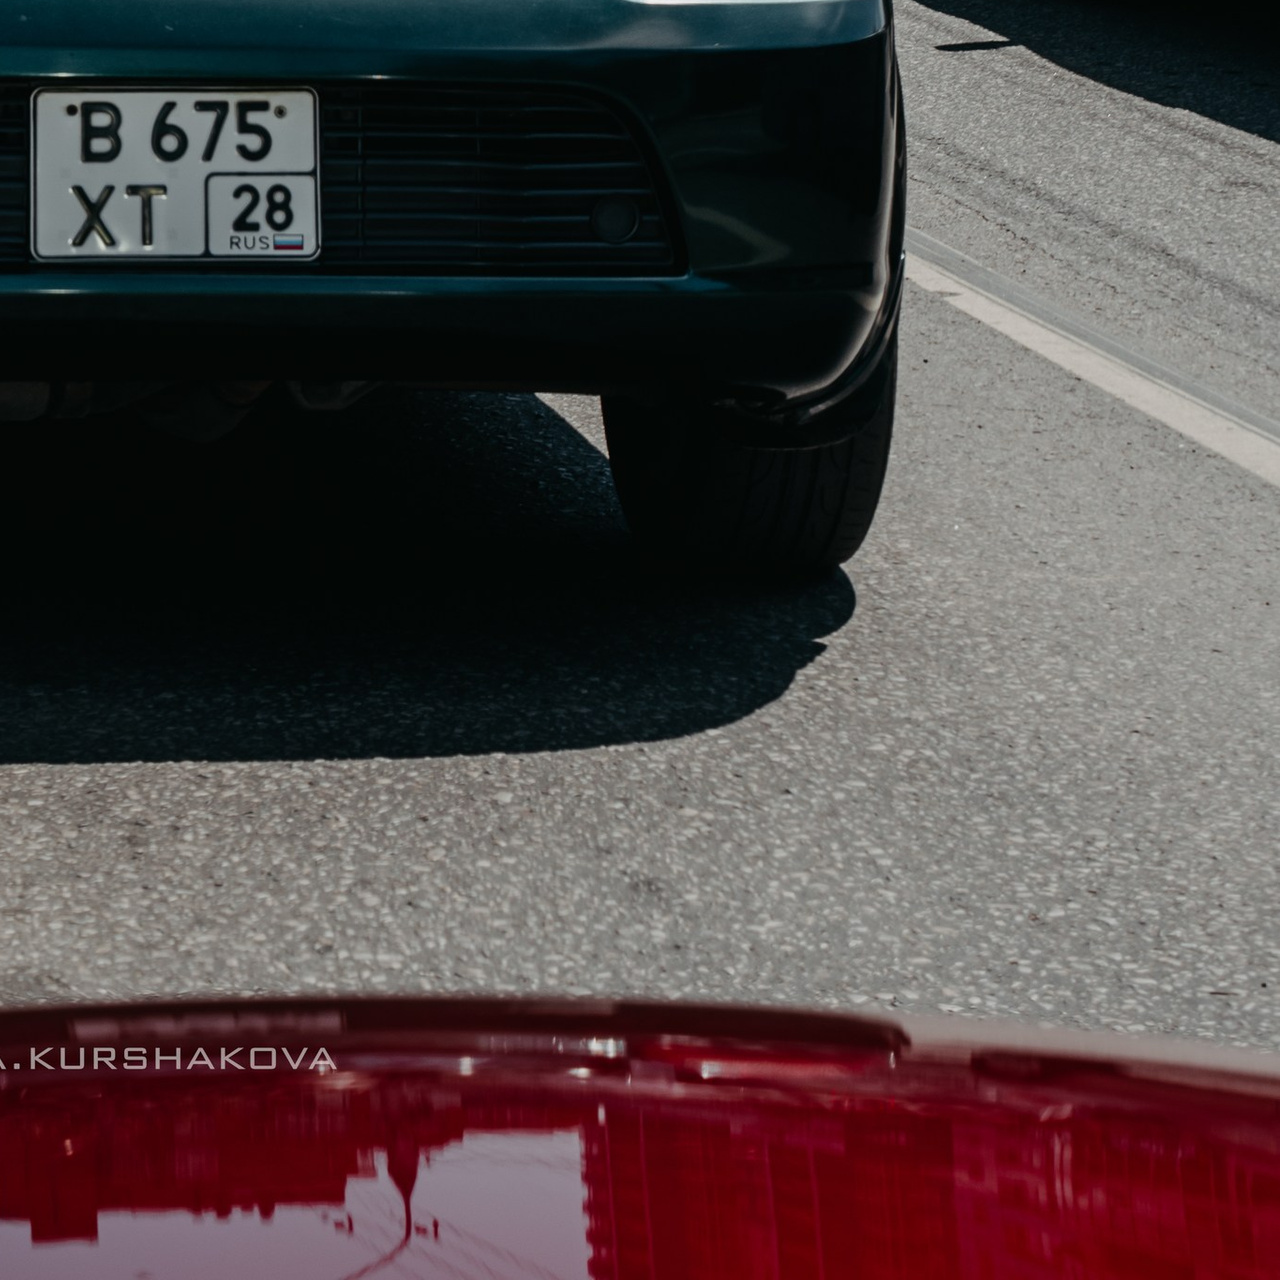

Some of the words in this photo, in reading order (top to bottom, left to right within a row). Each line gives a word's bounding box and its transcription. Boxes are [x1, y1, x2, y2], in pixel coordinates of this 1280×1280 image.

[151, 101, 273, 162] 675
[71, 185, 168, 247] ХТ
[232, 183, 294, 232] 28
[230, 235, 270, 250] RUS
